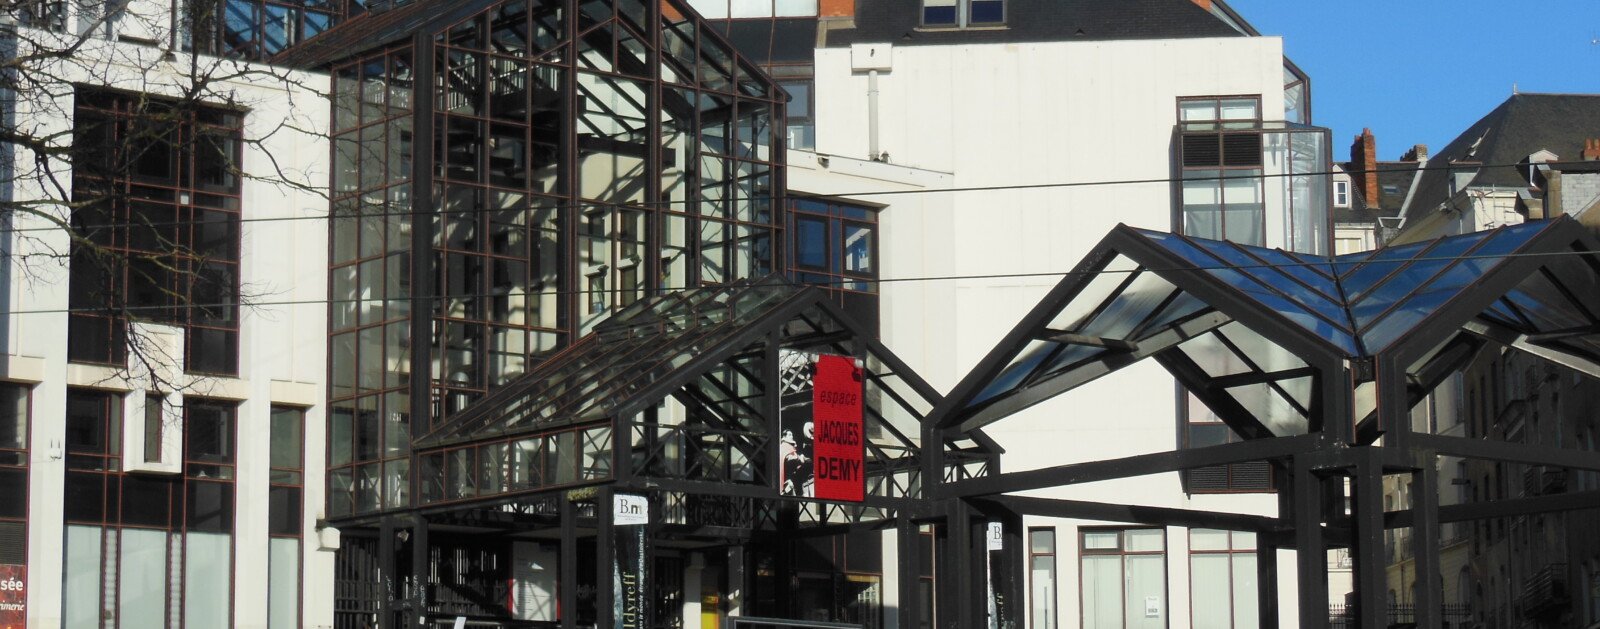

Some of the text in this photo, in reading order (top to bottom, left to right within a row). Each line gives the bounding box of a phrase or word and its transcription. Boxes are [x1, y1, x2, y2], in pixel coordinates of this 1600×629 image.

[820, 390, 857, 408] espace
[818, 420, 859, 447] JACQUES
[818, 456, 861, 482] DEMY
[0, 576, 24, 591] sée
